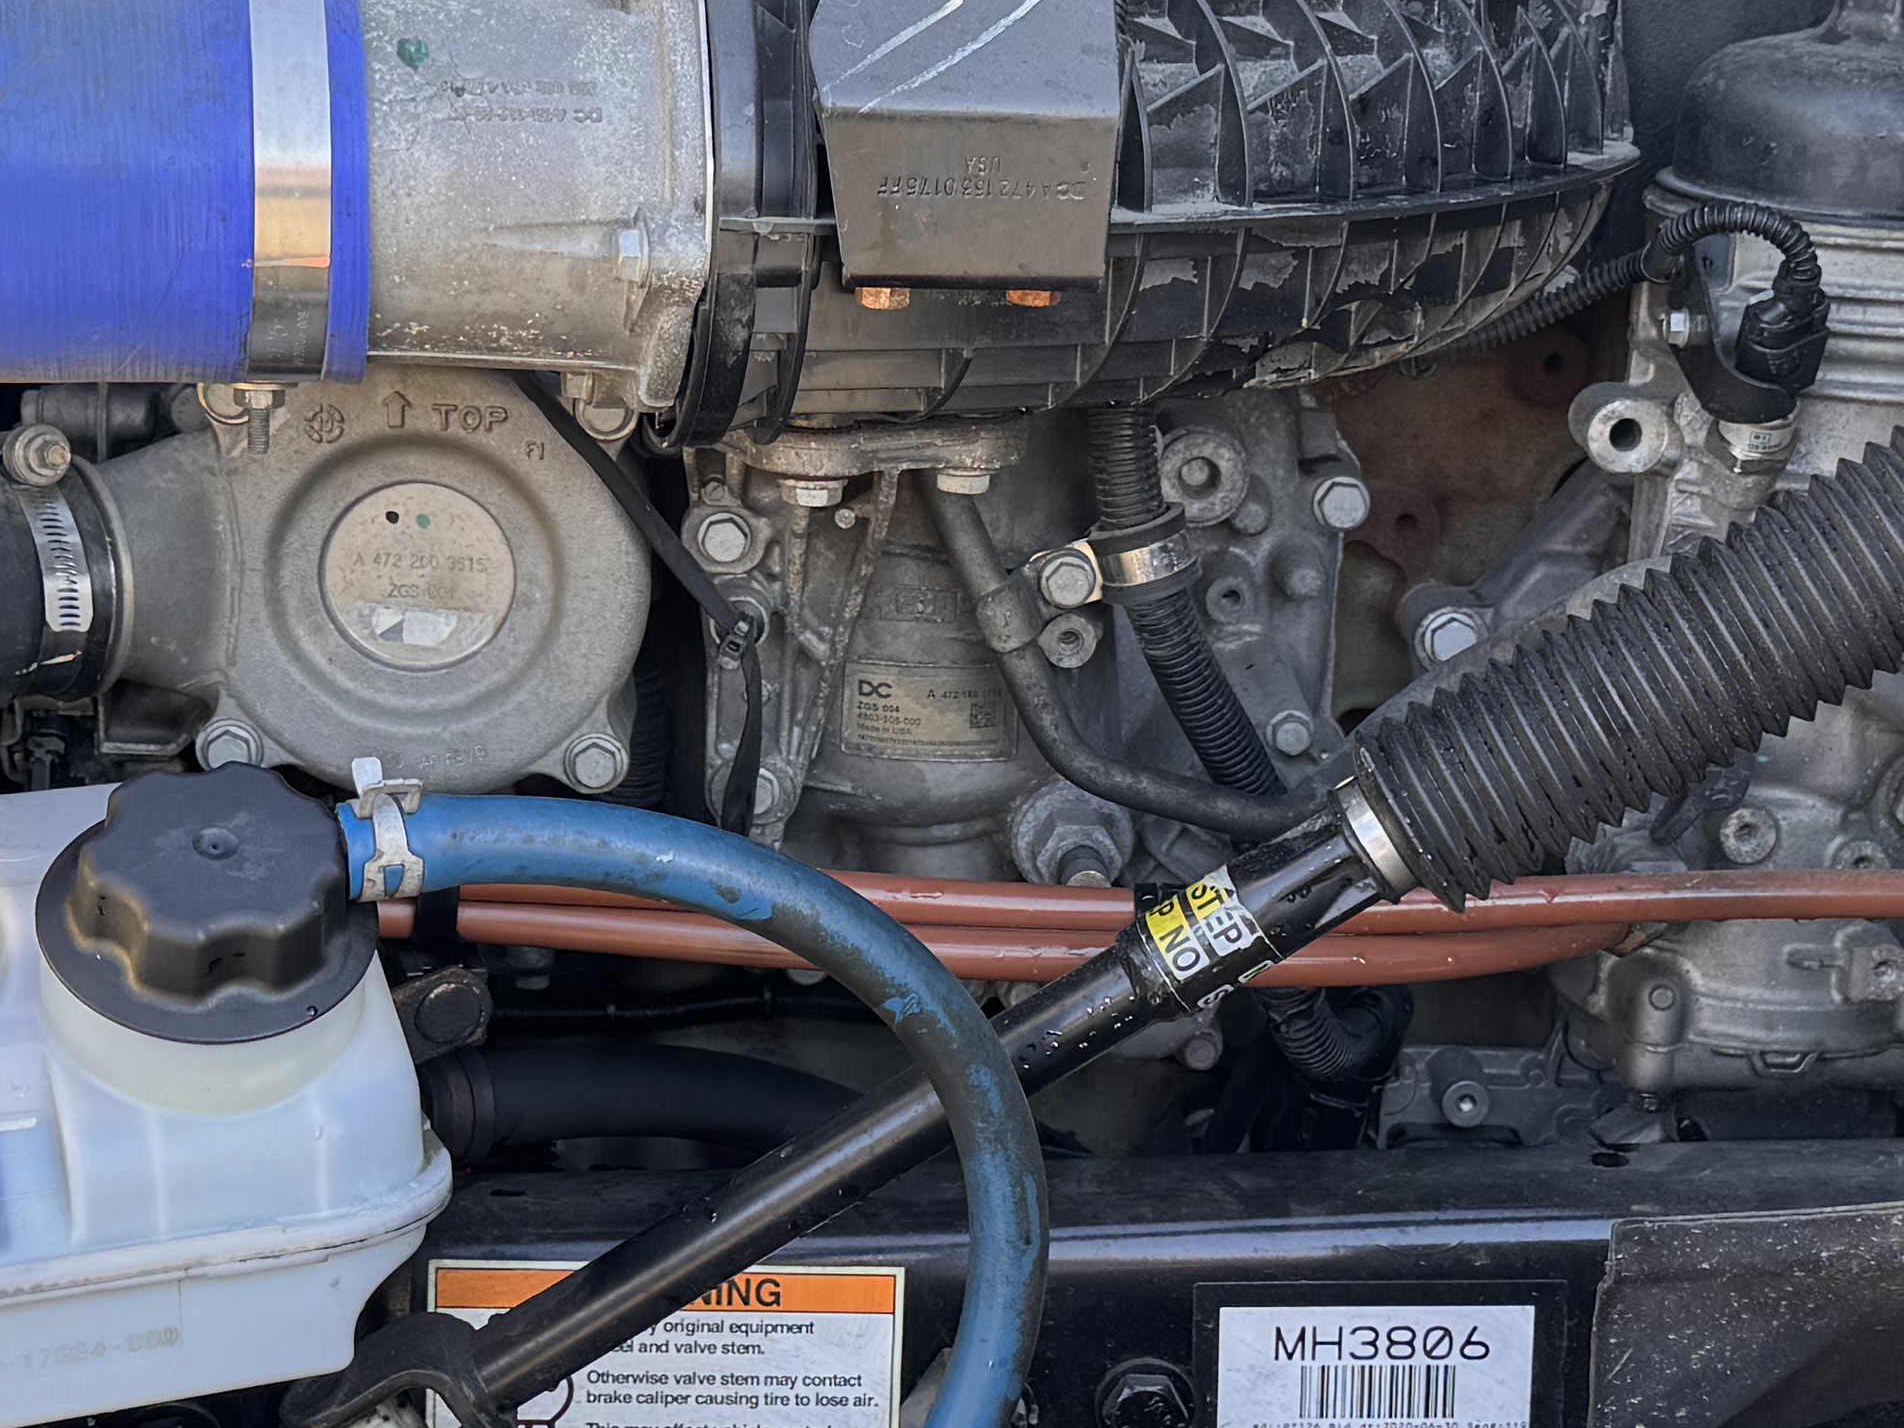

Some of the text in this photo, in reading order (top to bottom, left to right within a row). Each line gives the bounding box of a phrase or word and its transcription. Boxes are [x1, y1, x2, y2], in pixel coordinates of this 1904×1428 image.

[963, 154, 1002, 176] USA
[431, 402, 509, 434] TOP
[857, 678, 893, 700] DC
[663, 1318, 725, 1339] original
[729, 1320, 815, 1339] equipment
[638, 1339, 670, 1355] and
[674, 1339, 718, 1355] valve
[720, 1340, 765, 1356] stem.
[1273, 1325, 1491, 1362] MH3806
[586, 1369, 863, 1393] Otherwise valve stem may contact
[586, 1390, 880, 1410] brake caliper causing tire to lose air.
